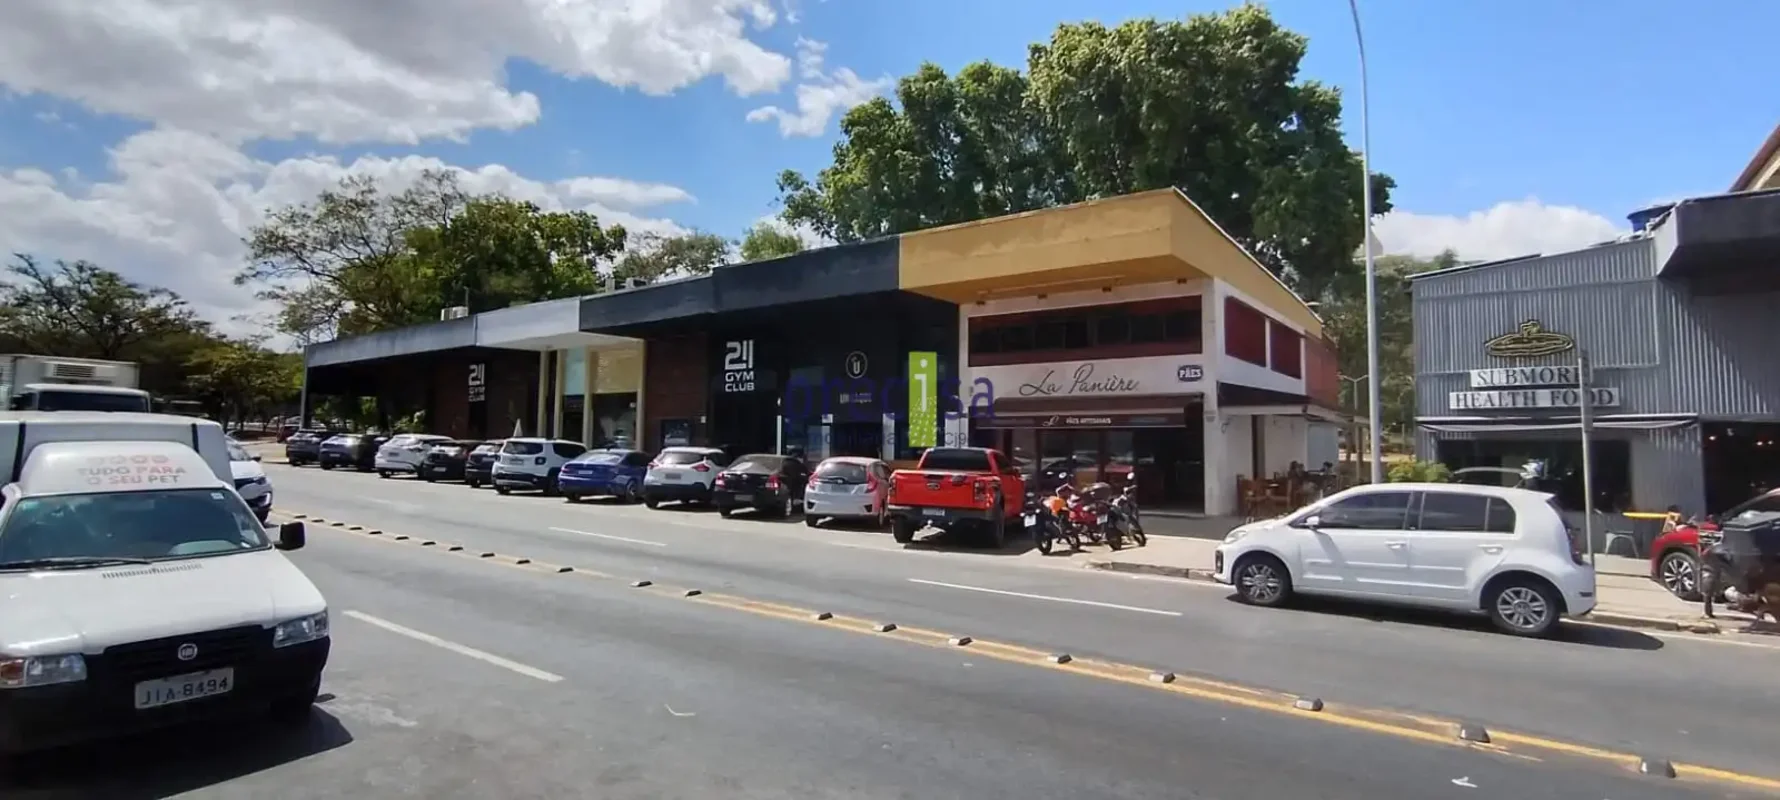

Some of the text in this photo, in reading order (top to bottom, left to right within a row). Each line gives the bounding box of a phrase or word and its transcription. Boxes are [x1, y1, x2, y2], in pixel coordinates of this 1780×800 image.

[725, 371, 754, 382] GYM
[1179, 367, 1201, 378] PÃES
[1019, 362, 1139, 396] La Panière
[725, 382, 755, 392] CLUB
[1455, 390, 1537, 408] HEALTH
[77, 465, 186, 475] TUDO PARA
[87, 474, 180, 485] O SEU PET
[140, 676, 228, 705] JIA-8494
